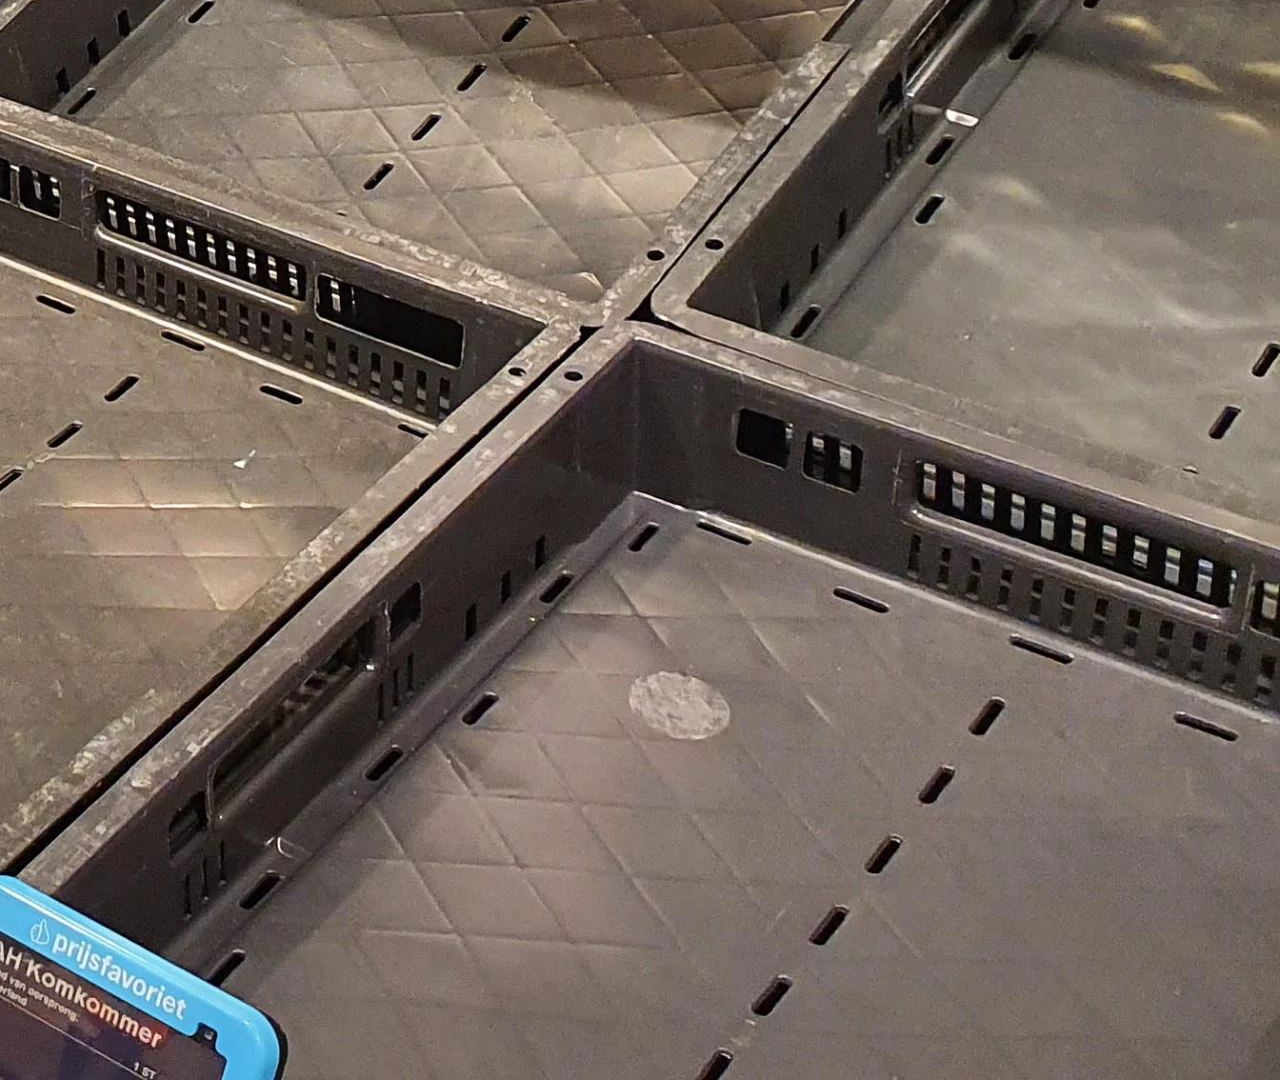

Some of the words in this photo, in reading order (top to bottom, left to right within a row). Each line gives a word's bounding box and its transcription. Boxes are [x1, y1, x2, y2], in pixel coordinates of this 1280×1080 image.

[8, 974, 27, 991] van
[25, 959, 164, 1049] Komkommer
[51, 931, 188, 1021] prijsfavoriet
